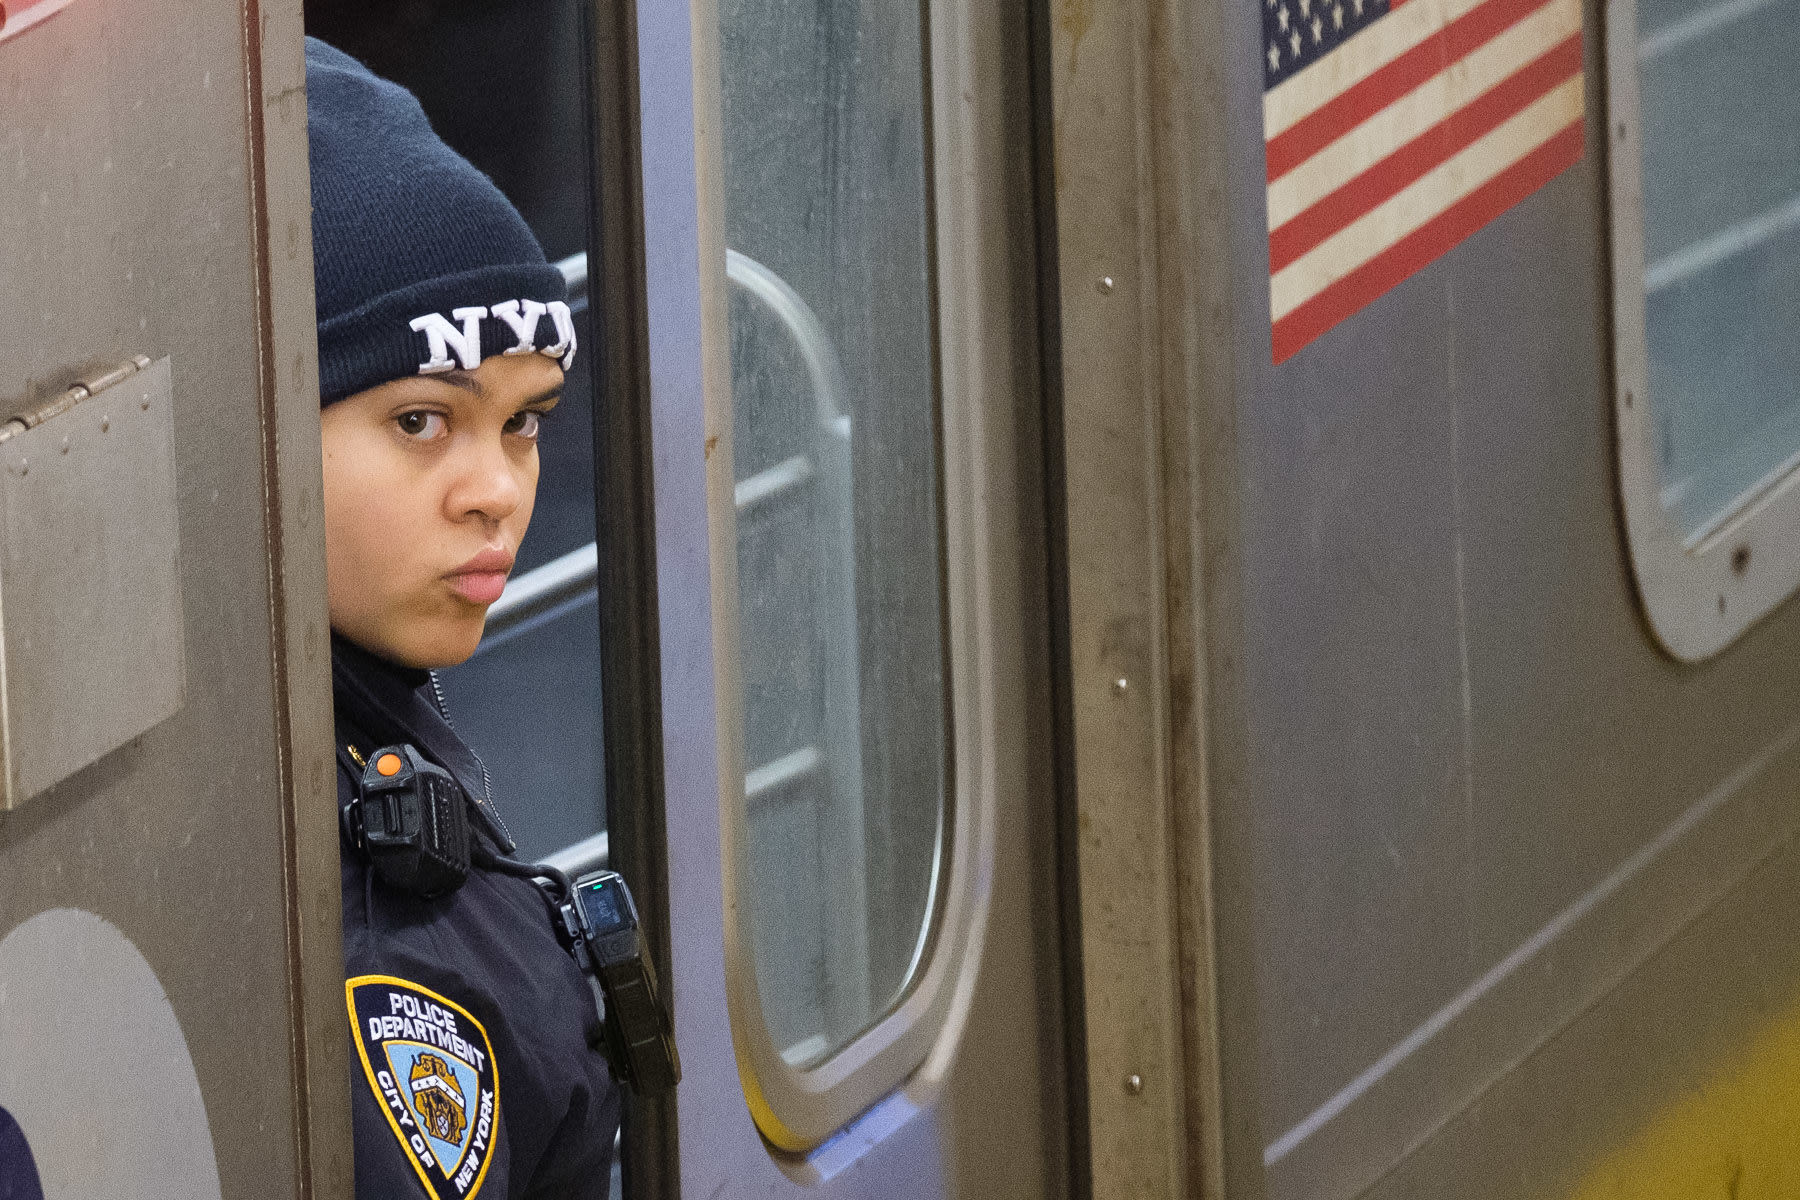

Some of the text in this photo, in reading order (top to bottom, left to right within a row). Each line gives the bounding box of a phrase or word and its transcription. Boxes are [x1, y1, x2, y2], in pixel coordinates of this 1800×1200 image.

[369, 1016, 485, 1072] DEPARTMENT
[389, 992, 457, 1034] POLICE
[377, 1070, 435, 1169] CITY OF
[454, 1088, 494, 1194] NEW YORK
